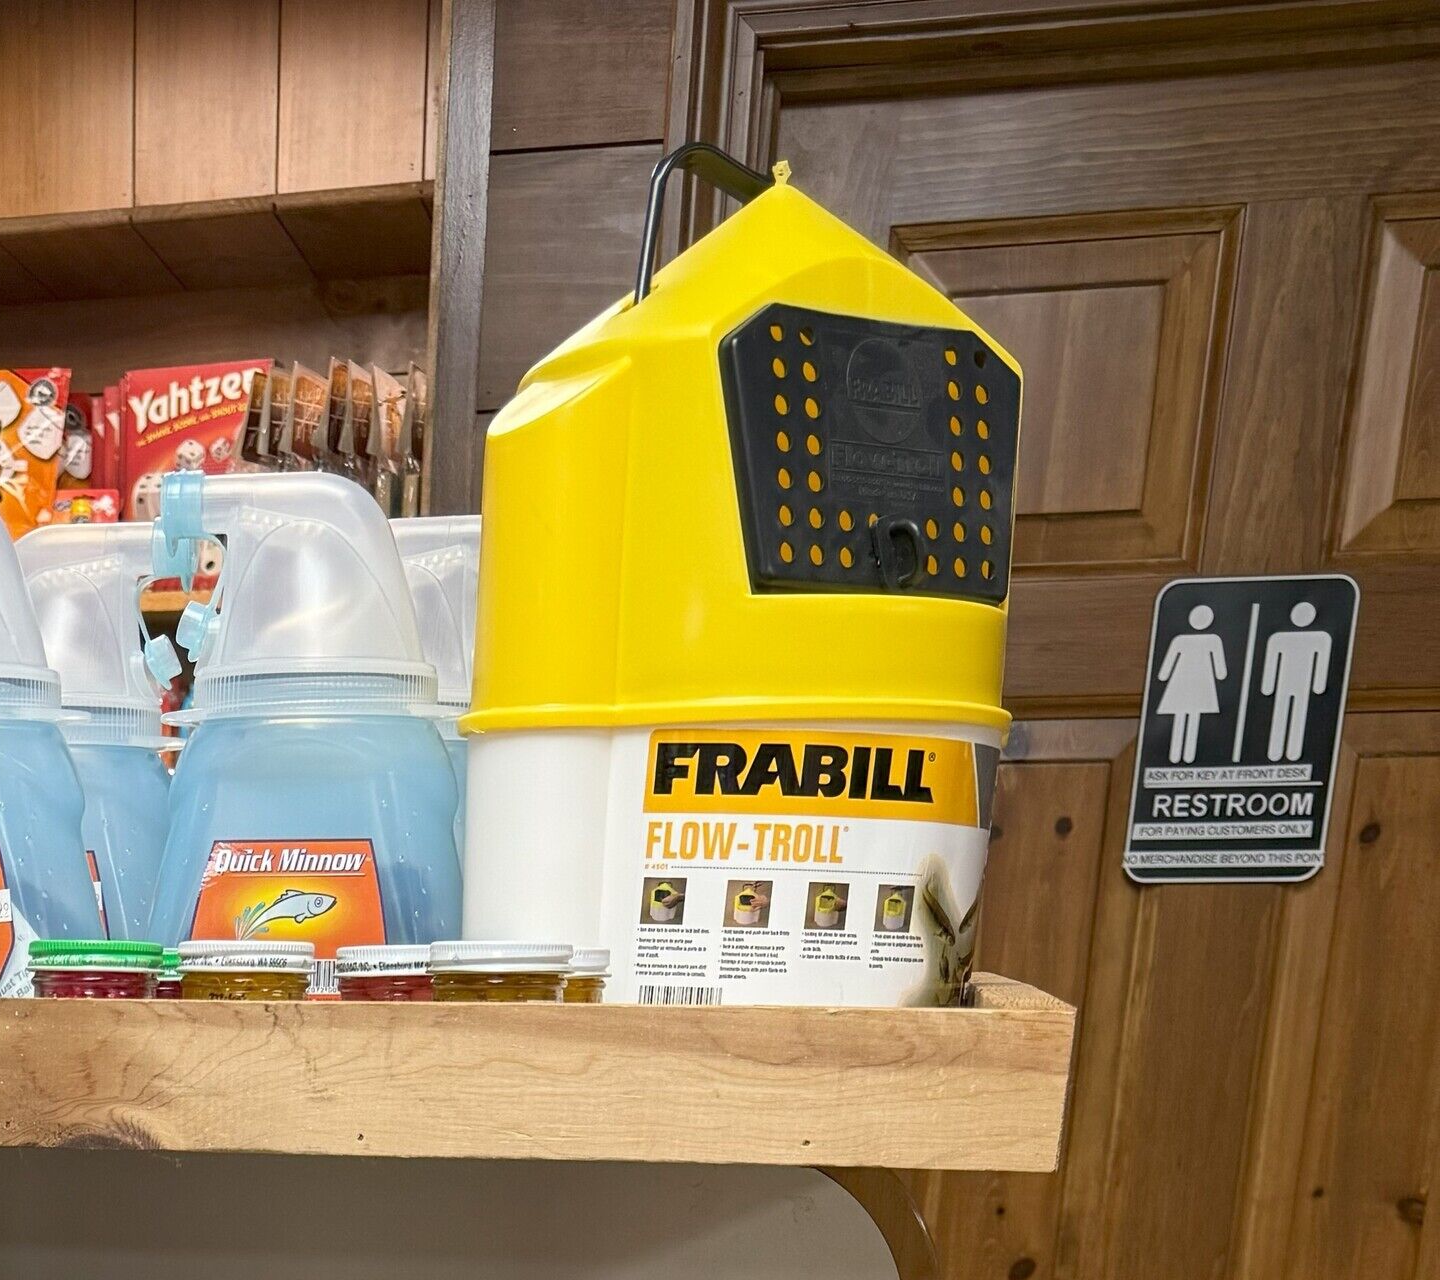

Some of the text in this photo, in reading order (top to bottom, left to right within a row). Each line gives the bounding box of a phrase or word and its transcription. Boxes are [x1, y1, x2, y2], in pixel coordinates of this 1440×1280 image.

[1172, 770, 1195, 781] FOR
[1196, 770, 1219, 781] KEY
[1220, 769, 1236, 780] AT
[1239, 768, 1274, 779] FRONT
[1276, 767, 1307, 778] DESK
[1152, 793, 1314, 817] RESTROOM
[1165, 825, 1205, 836] PAYING
[1207, 824, 1277, 836] CUSTOMERS
[1279, 824, 1309, 834] ONLY
[1140, 854, 1218, 865] MERCHANDISE
[1220, 853, 1265, 864] BEYOND
[1268, 853, 1292, 863] THIS
